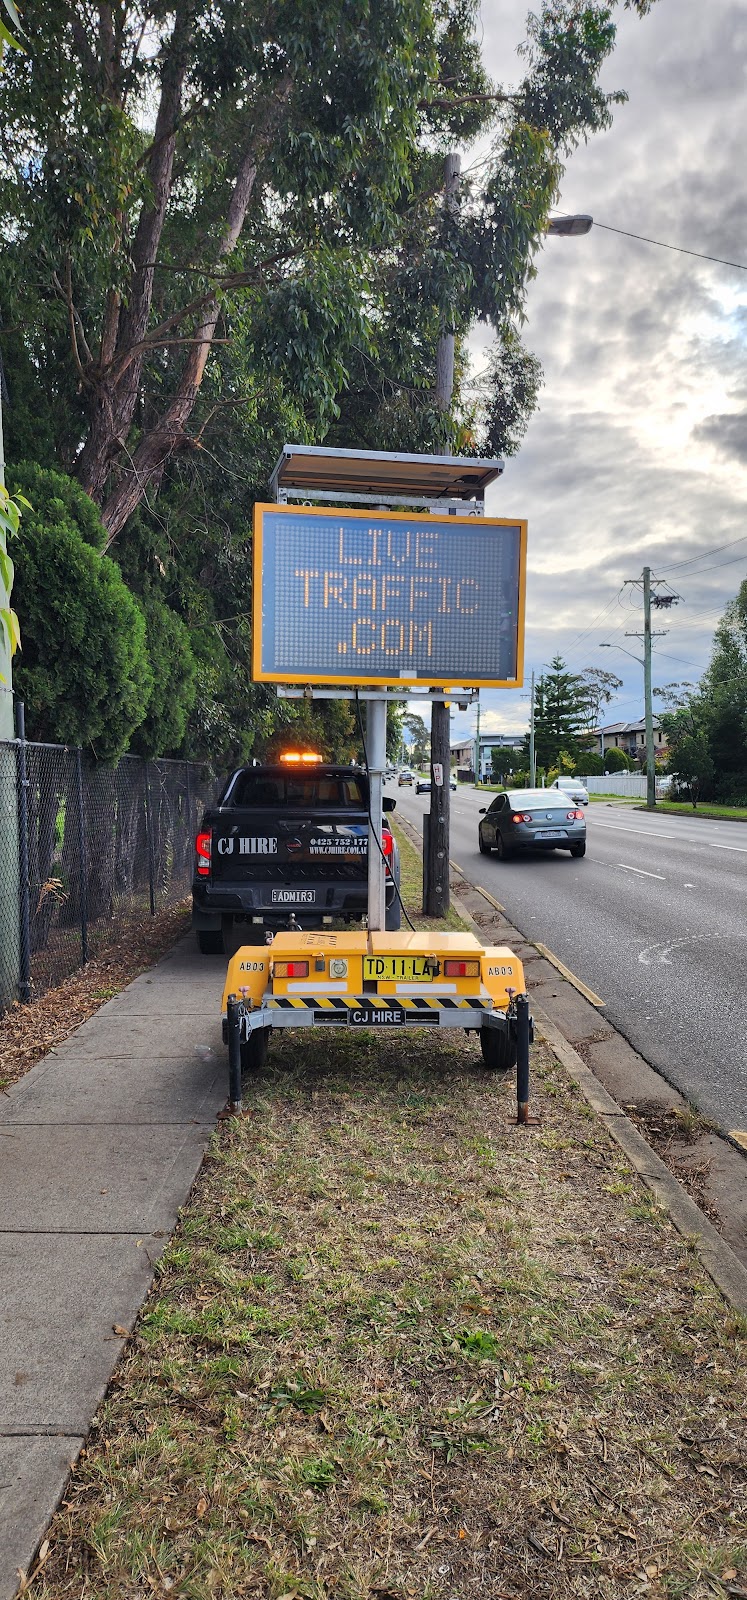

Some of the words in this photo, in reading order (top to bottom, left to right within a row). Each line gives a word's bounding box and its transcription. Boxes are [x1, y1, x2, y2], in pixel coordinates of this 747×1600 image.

[339, 527, 439, 568] LIVE
[294, 570, 480, 614] TRAFFIC
[337, 617, 432, 657] .COM
[217, 837, 234, 854] CJ
[239, 837, 278, 854] HIRE
[310, 838, 332, 846] 0425
[334, 838, 351, 846] 752
[353, 838, 368, 846] 177
[278, 891, 313, 901] ADMIR3
[353, 1011, 368, 1023] CJ
[372, 1011, 401, 1023] HIRE
